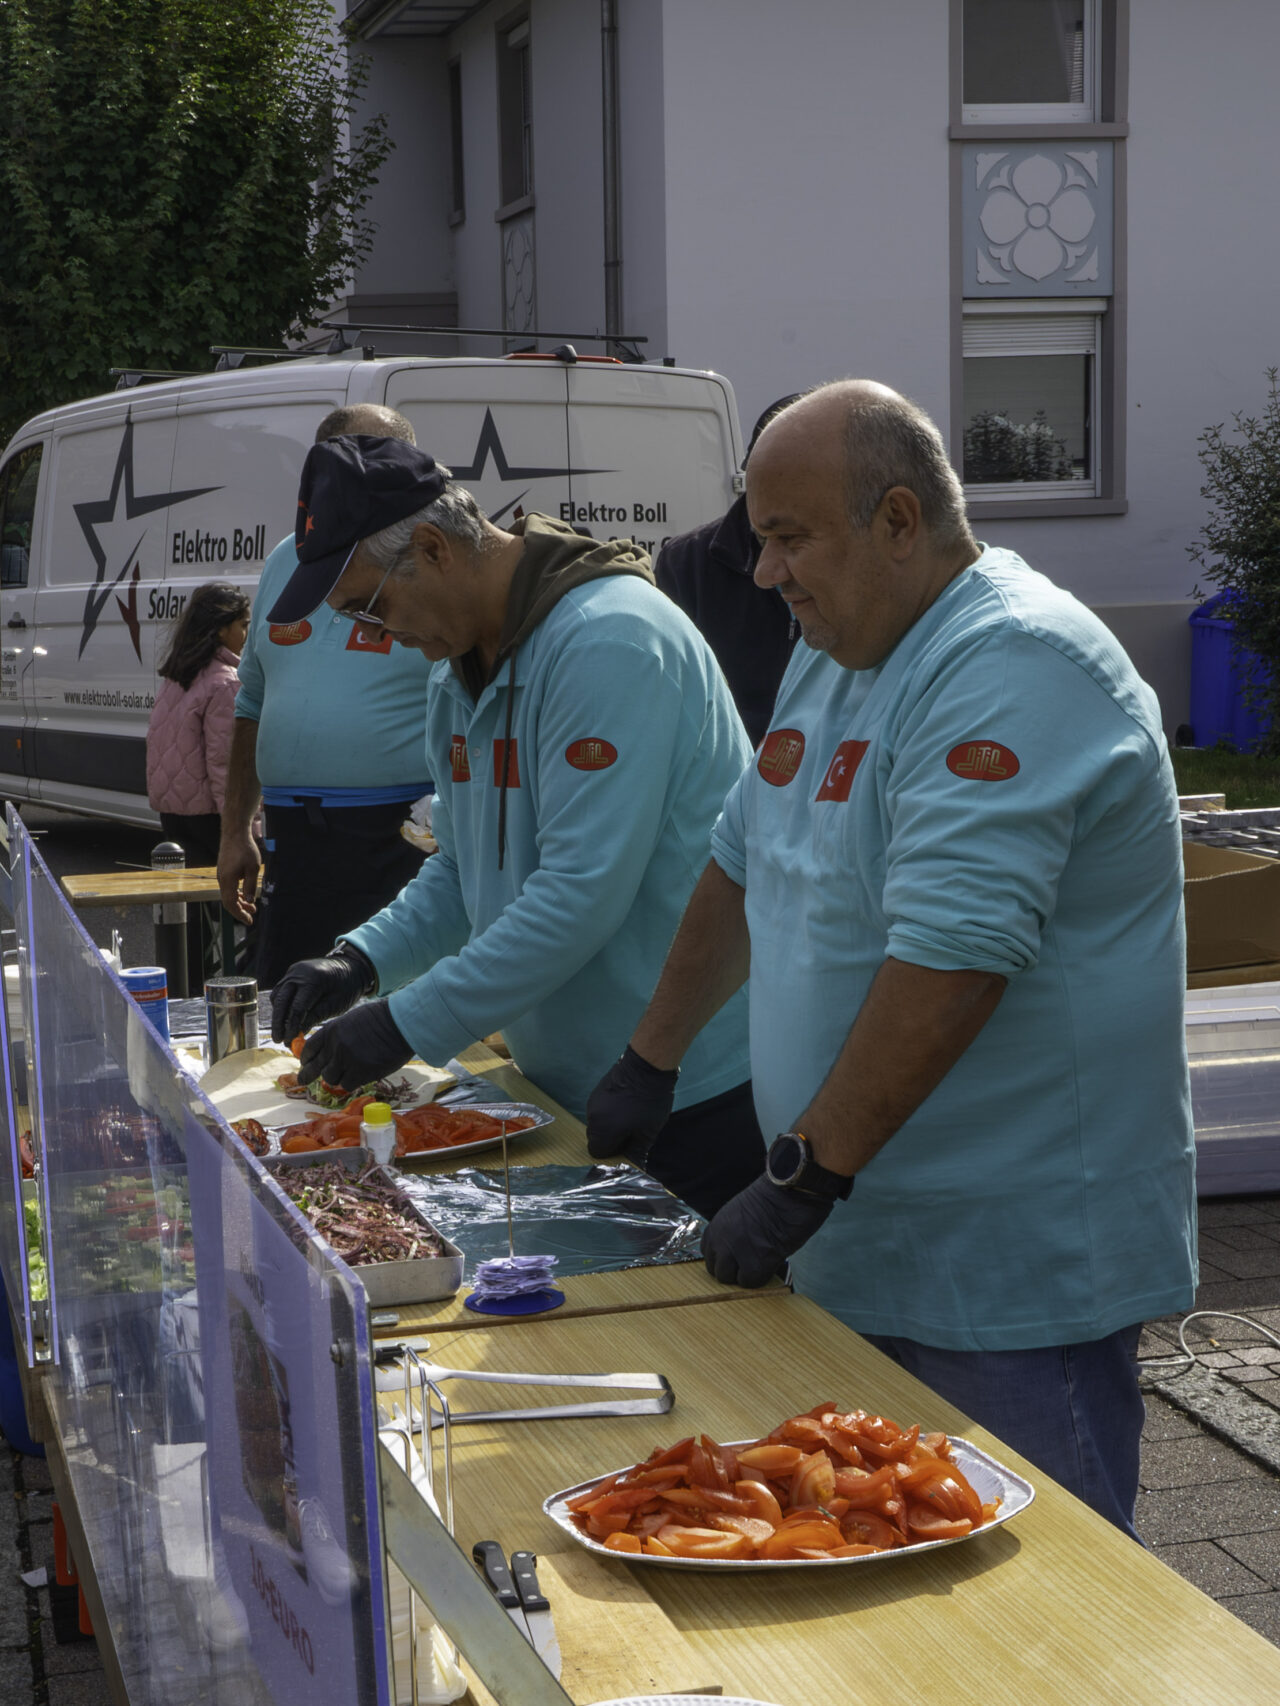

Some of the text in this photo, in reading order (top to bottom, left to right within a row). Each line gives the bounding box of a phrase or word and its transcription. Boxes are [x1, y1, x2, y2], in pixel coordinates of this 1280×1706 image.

[560, 501, 667, 523] Elektro Boll
[172, 524, 266, 564] Elektro Boll
[148, 586, 186, 619] Solar
[63, 688, 155, 709] www.elektroboll-solar.de
